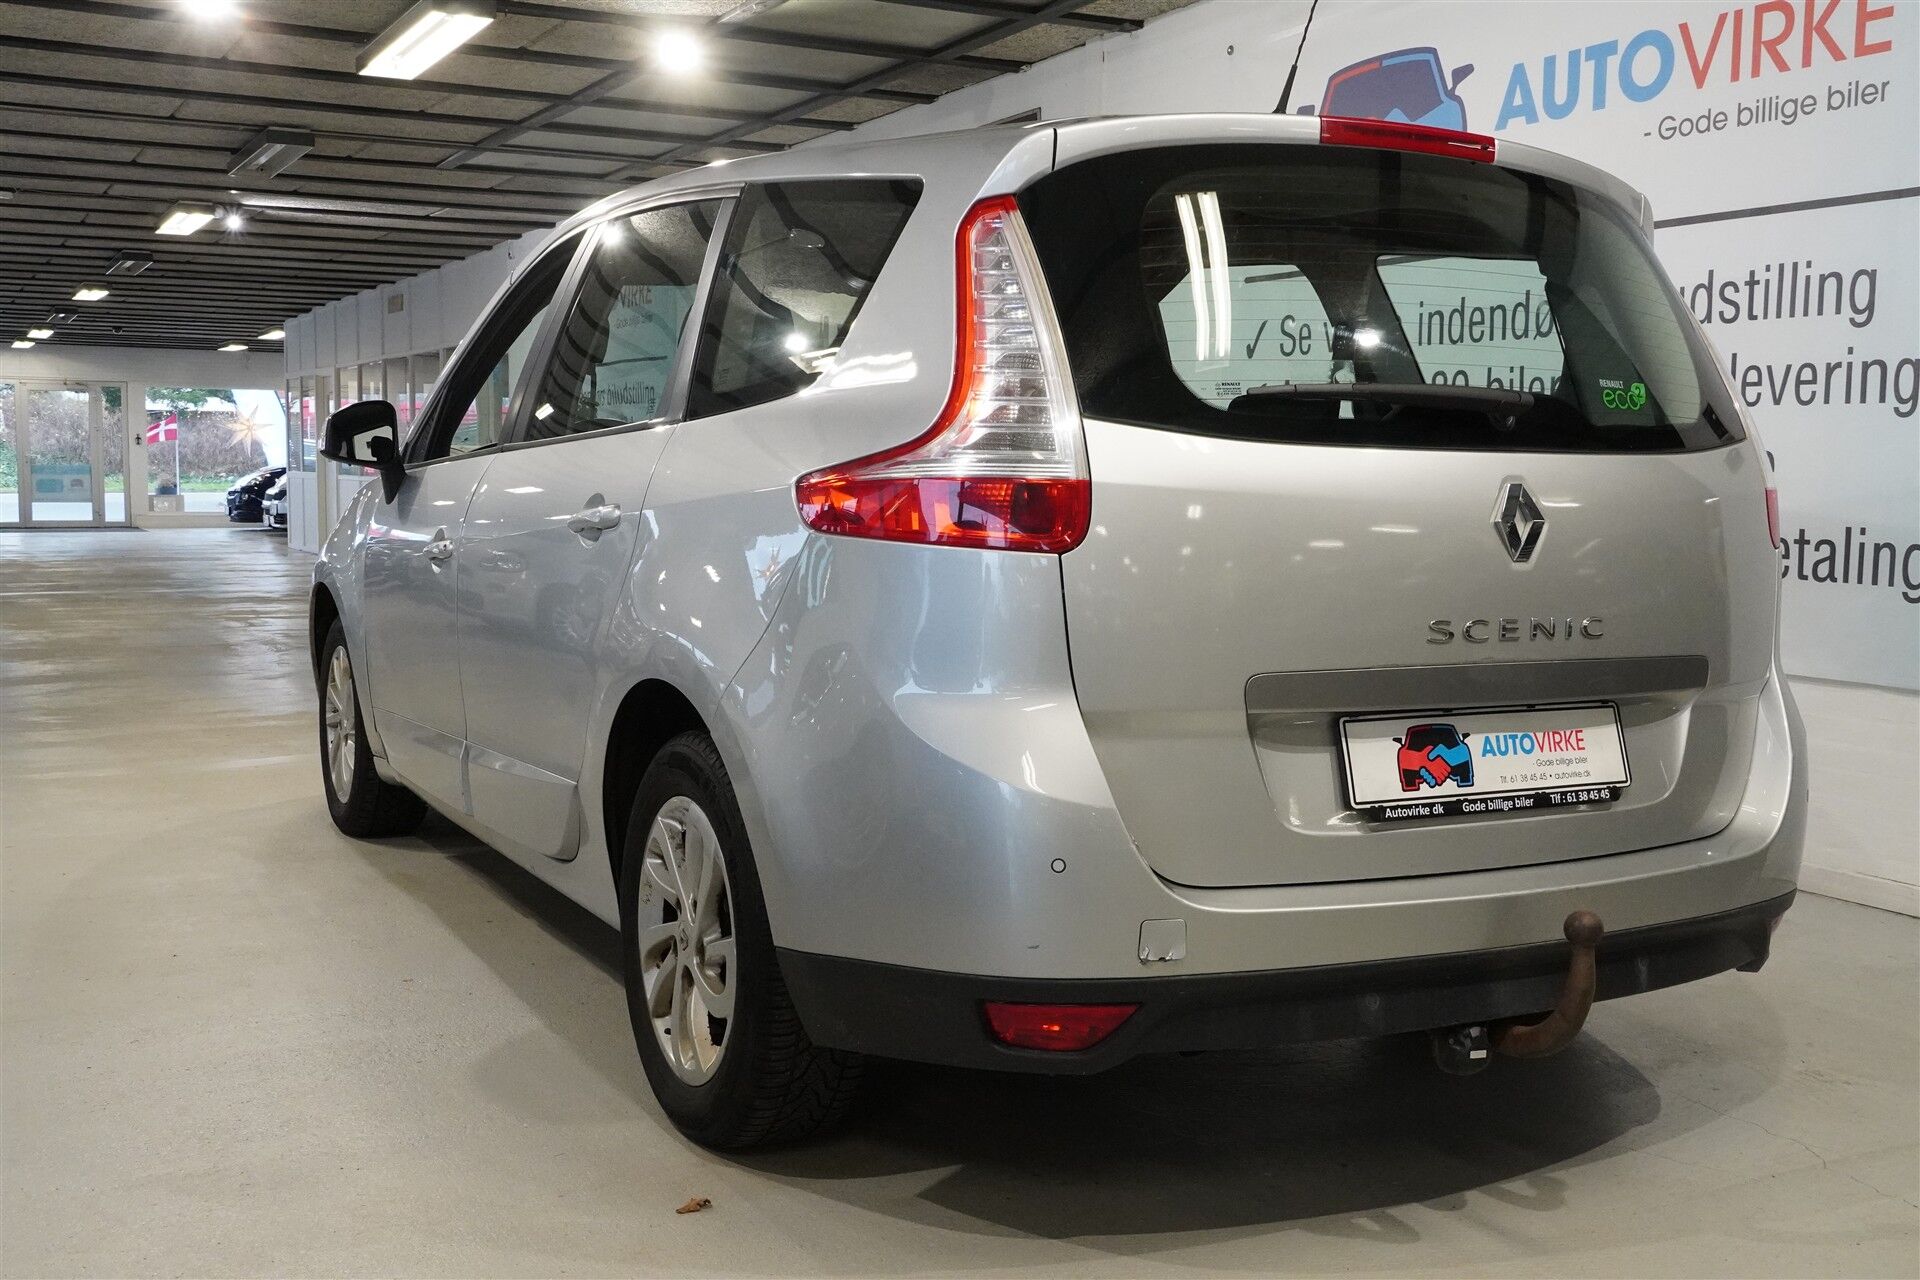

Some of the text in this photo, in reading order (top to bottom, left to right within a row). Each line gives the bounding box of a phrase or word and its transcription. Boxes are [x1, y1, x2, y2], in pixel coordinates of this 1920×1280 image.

[1494, 0, 1895, 131] AUTOVIRKE
[1658, 108, 1728, 140] Gode
[1737, 94, 1817, 125] billige
[1826, 80, 1890, 111] biler
[1280, 314, 1312, 357] Se
[1679, 260, 1877, 328] dstilling
[1599, 379, 1624, 389] RENAULT
[1426, 616, 1604, 644] SCENIC
[1481, 730, 1586, 758] AUTOVIRKE
[1536, 758, 1554, 767] Gode
[1510, 774, 1518, 783] 61
[1520, 774, 1529, 783] 38
[1530, 773, 1538, 782] 45
[1540, 772, 1548, 781] 45
[1385, 807, 1430, 818] Autovirke
[1432, 805, 1444, 815] dk
[1462, 801, 1486, 812] Gode
[1488, 798, 1514, 813] billige
[1515, 796, 1534, 808] biler
[1550, 793, 1561, 804] Tlf
[1567, 791, 1577, 802] 61
[1579, 790, 1588, 801] 38
[1589, 789, 1600, 800] 45
[1600, 788, 1610, 799] 45
